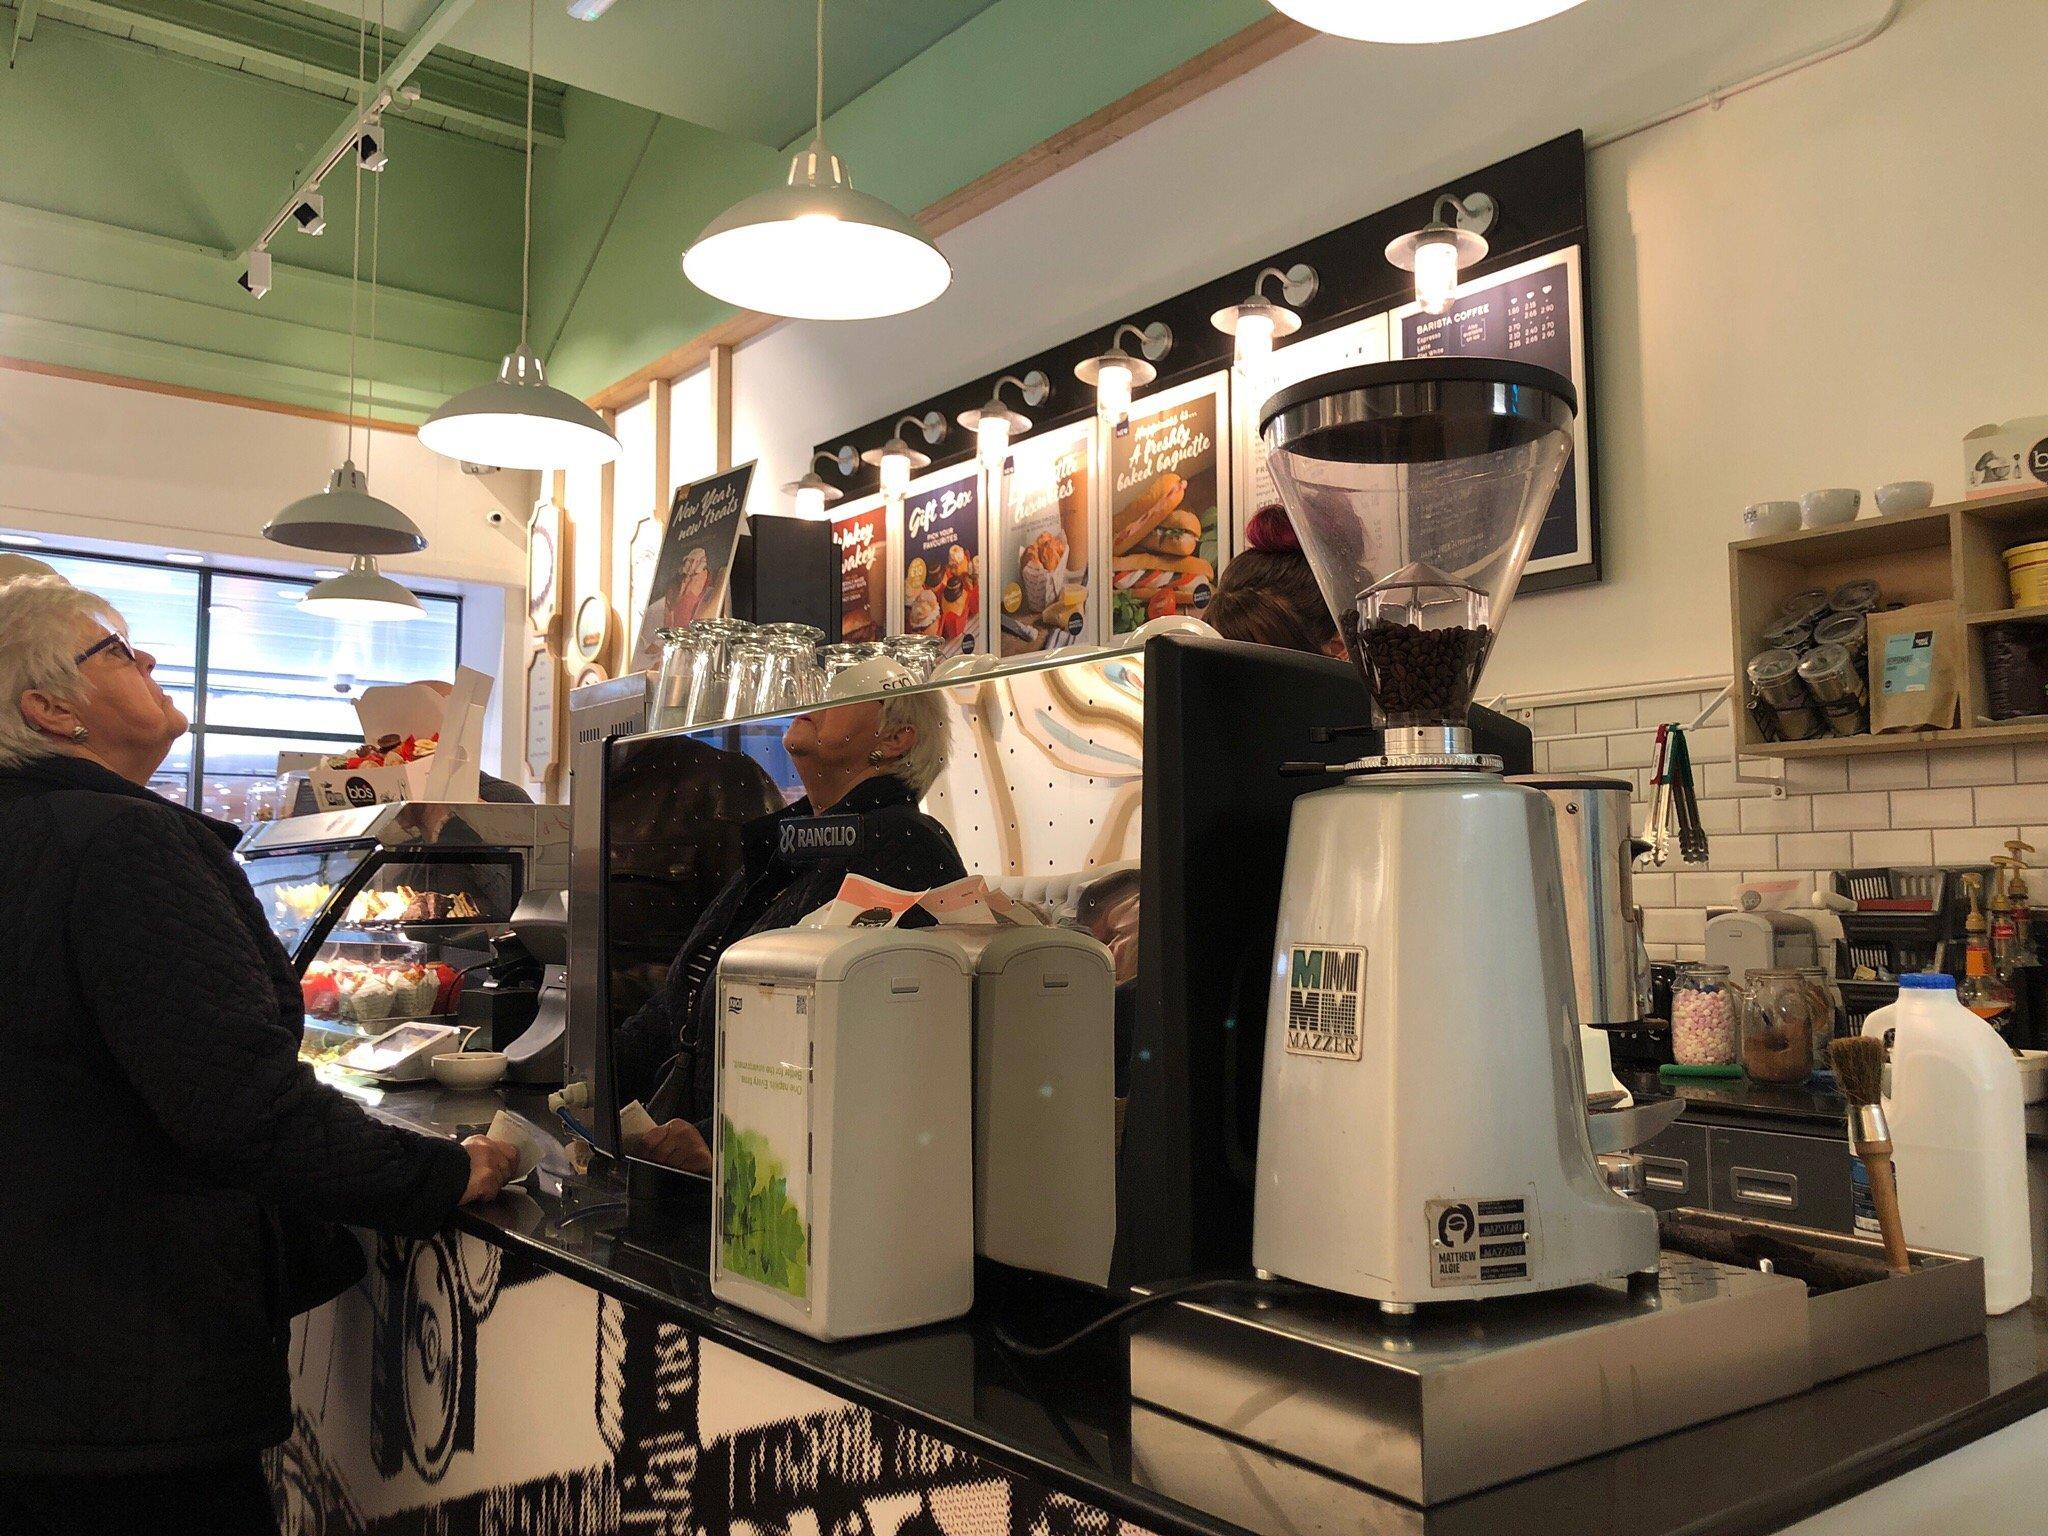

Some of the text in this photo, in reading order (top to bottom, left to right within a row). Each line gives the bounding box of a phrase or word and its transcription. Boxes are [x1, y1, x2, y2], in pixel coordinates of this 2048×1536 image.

[1416, 315, 1452, 335] BARISTA
[1454, 303, 1490, 323] COFFEE
[1129, 423, 1191, 468] A freshly
[1117, 458, 1153, 491] baked
[1156, 432, 1211, 472] baguette
[673, 501, 700, 527] New
[678, 496, 739, 541] new treats
[908, 498, 938, 539] Gift
[940, 489, 973, 519] Box
[922, 533, 958, 550] FAVOURITES
[347, 785, 374, 799] bbs
[797, 826, 857, 848] RANCILIO
[1287, 1030, 1358, 1055] MAZZER
[789, 1083, 803, 1096] One
[1438, 1251, 1476, 1263] MATTHEW
[1440, 1263, 1460, 1274] ALGIE
